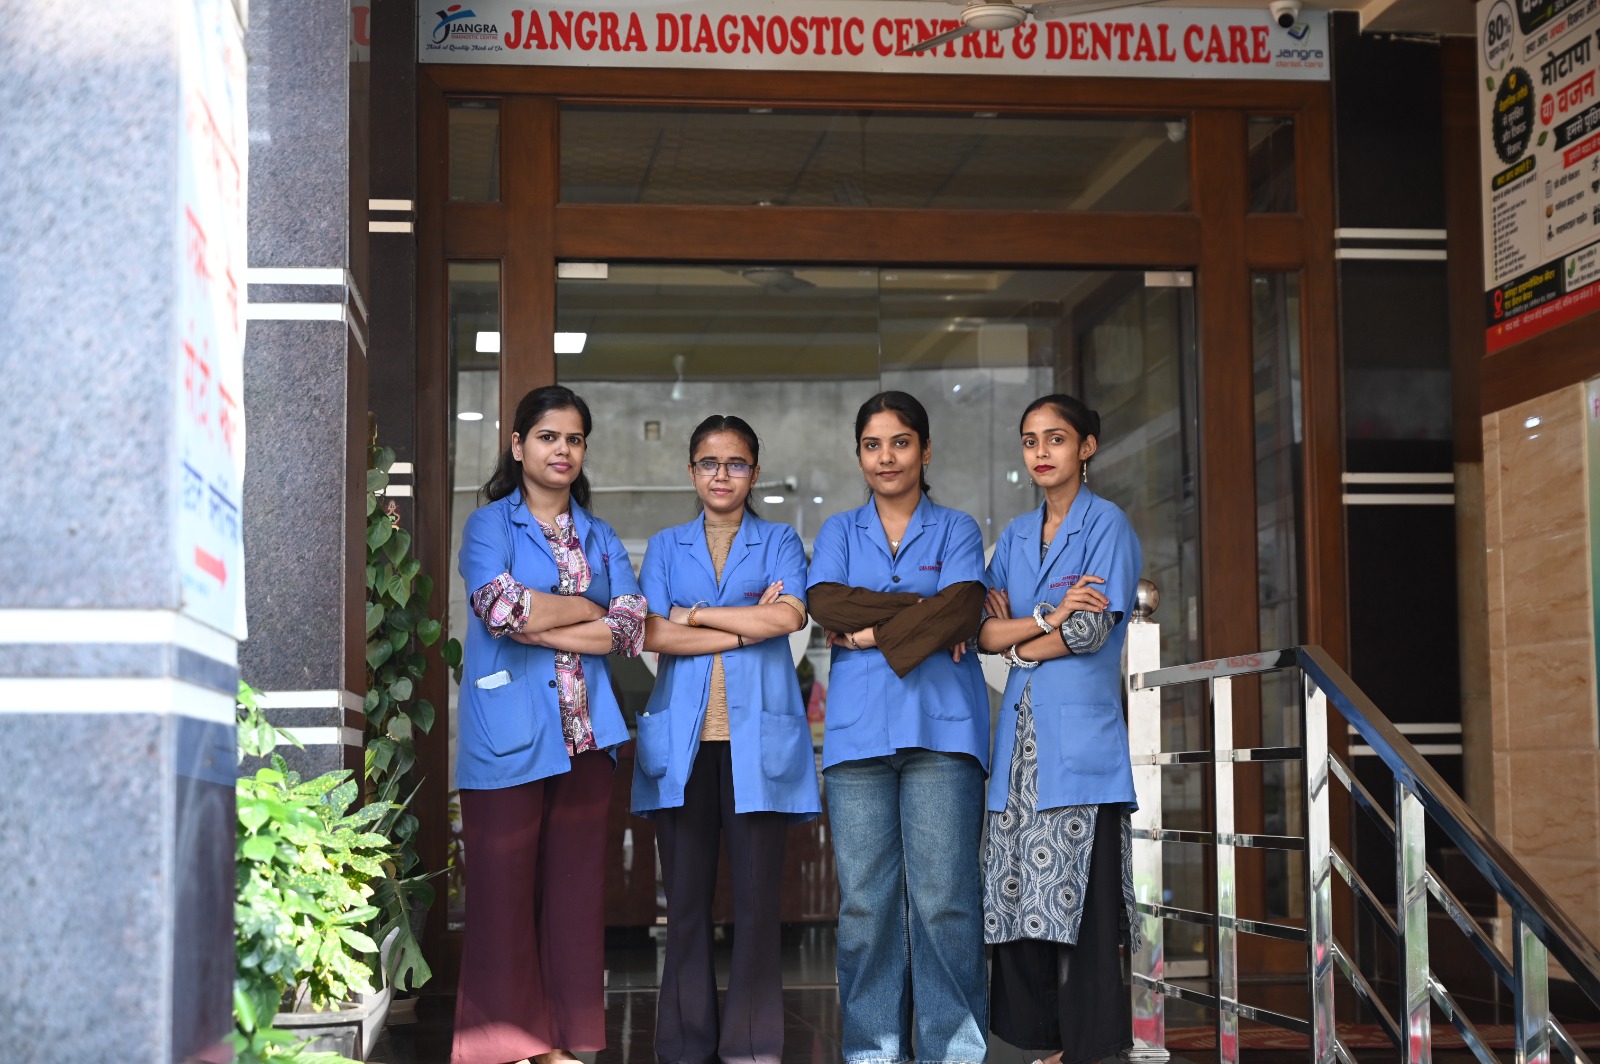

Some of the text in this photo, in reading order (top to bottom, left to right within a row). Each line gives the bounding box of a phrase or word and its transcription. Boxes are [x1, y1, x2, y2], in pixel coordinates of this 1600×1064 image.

[451, 24, 498, 33] JANGRA
[504, 9, 1271, 63] JANGRA DIAGNOSTIC CENTRE & DENTAL CARE
[1541, 34, 1592, 86] मोटापा
[1557, 69, 1596, 112] वजन
